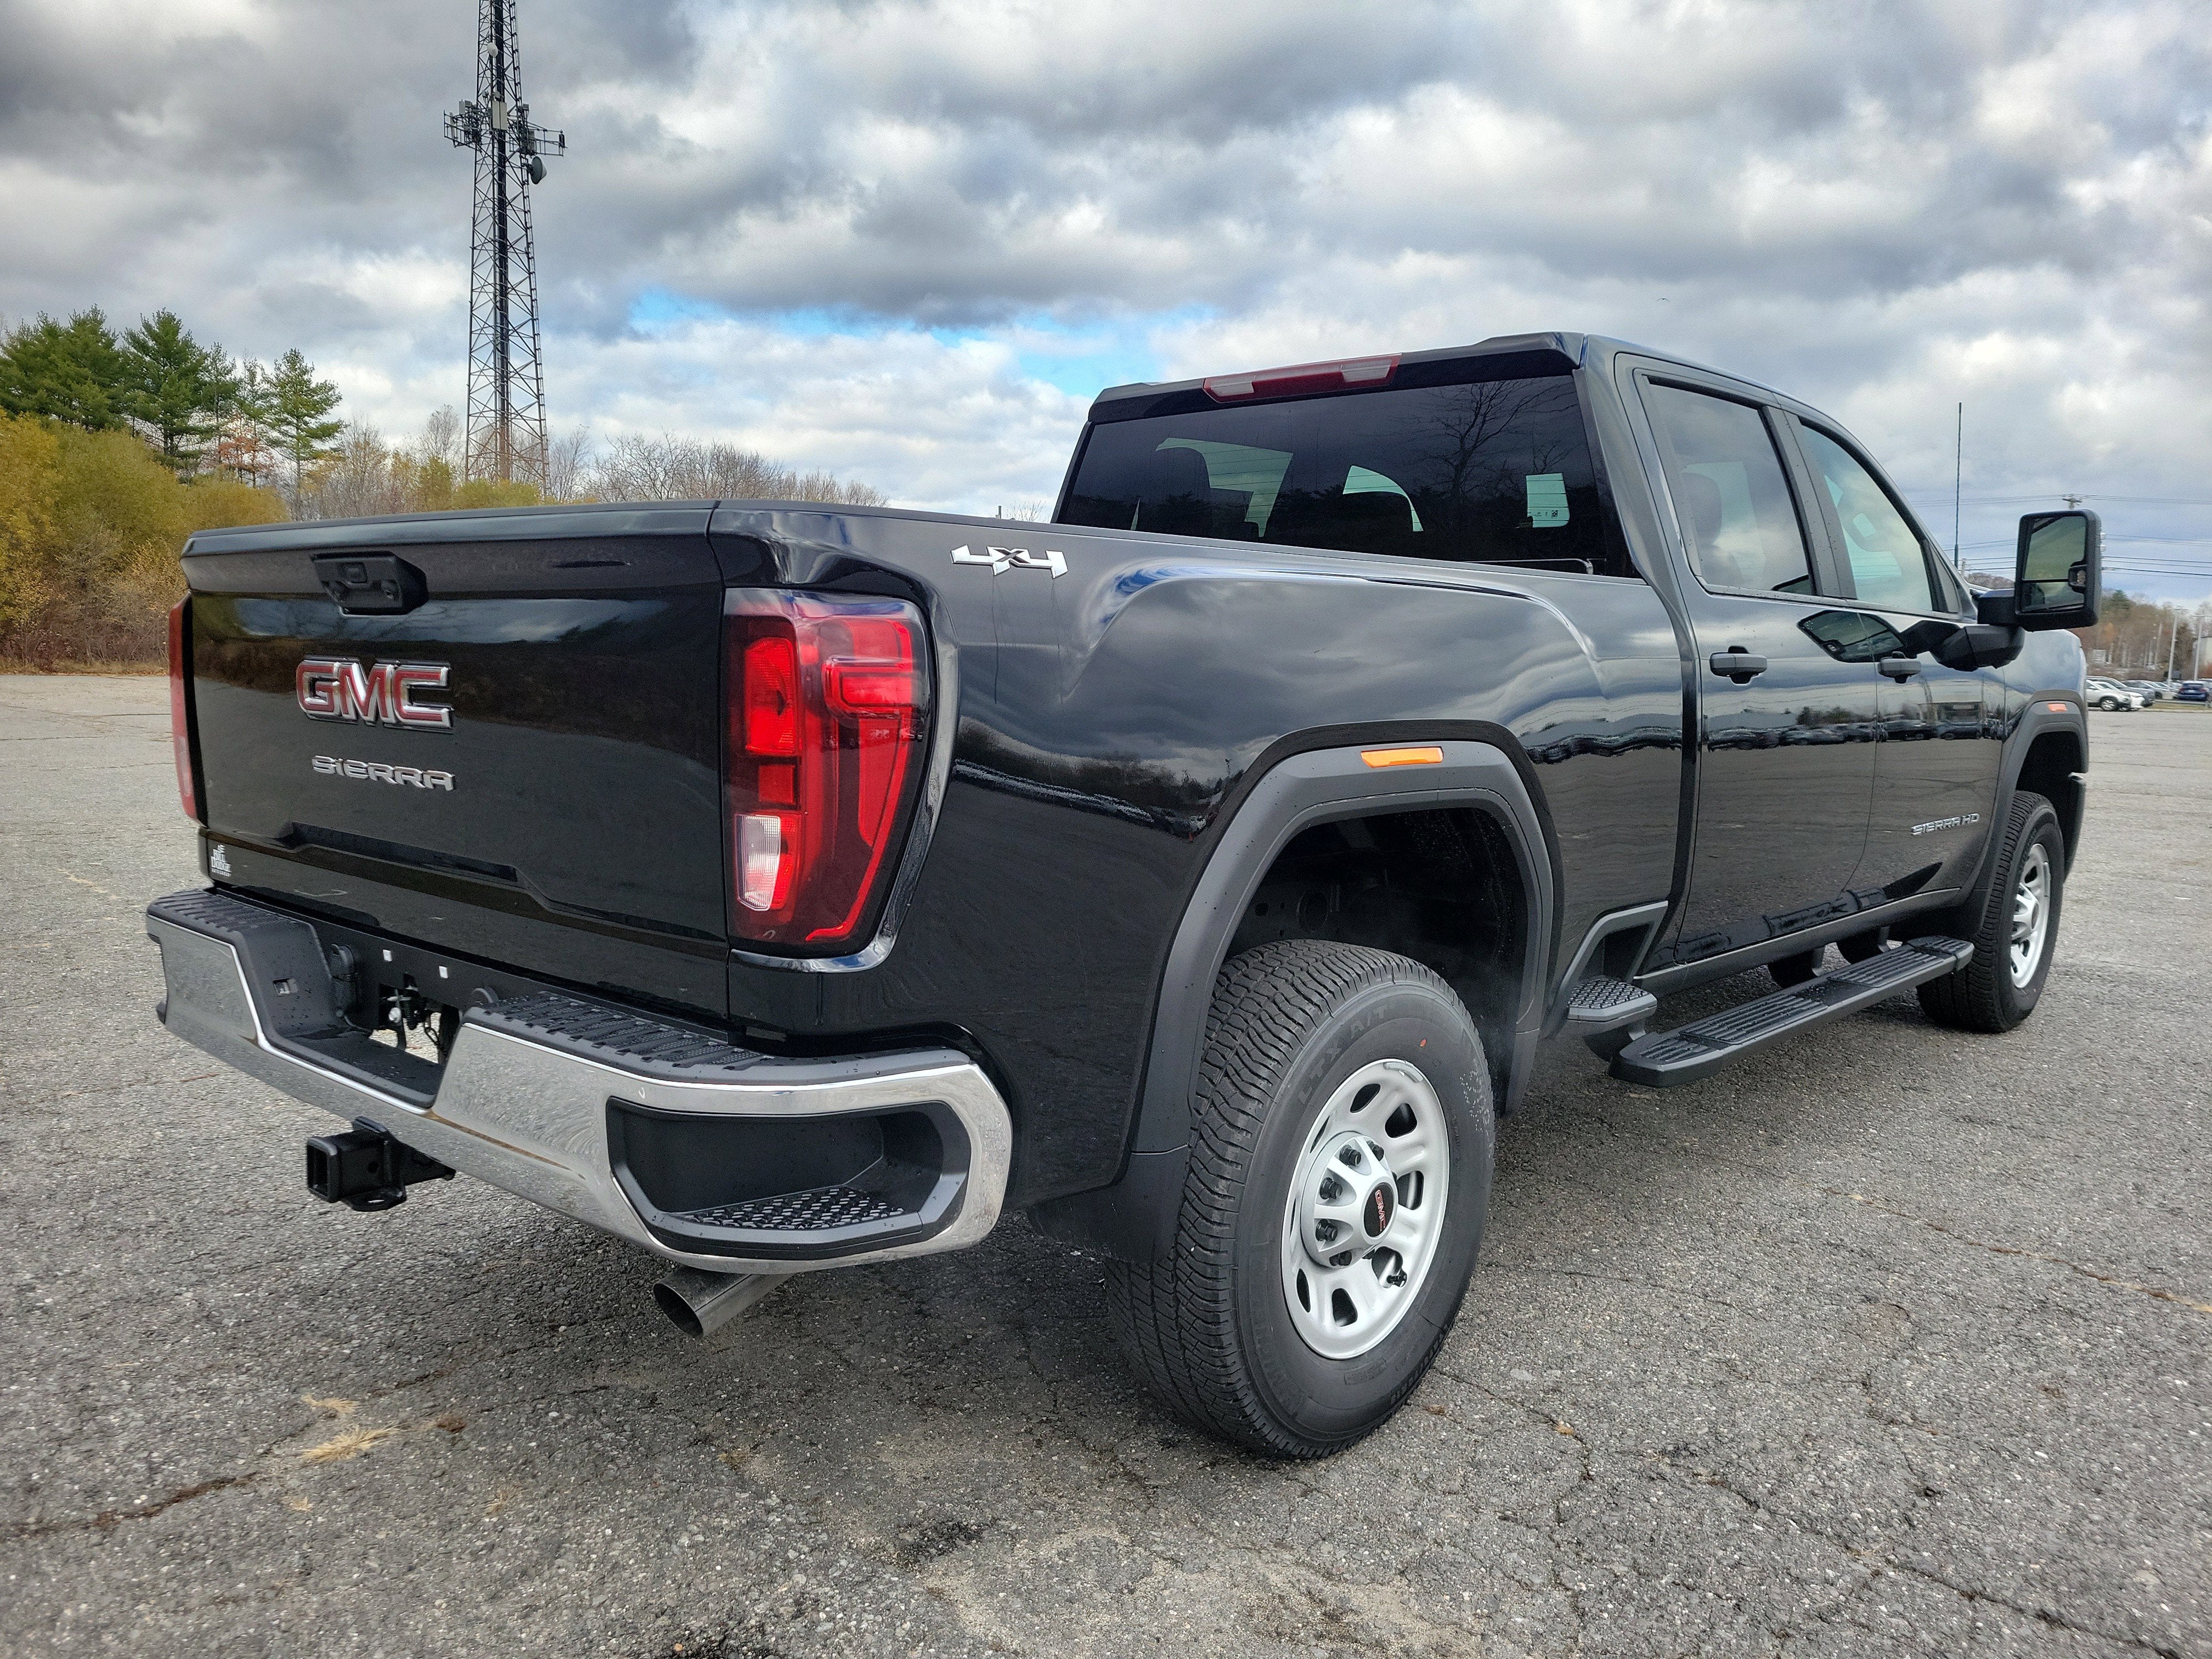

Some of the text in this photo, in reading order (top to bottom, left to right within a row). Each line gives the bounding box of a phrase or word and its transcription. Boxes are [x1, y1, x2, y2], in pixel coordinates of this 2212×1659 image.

[296, 657, 454, 734] GMC
[312, 755, 456, 791] SIERRA
[1910, 813, 1980, 836] SIERRA HD
[1375, 1189, 1386, 1232] GMC
